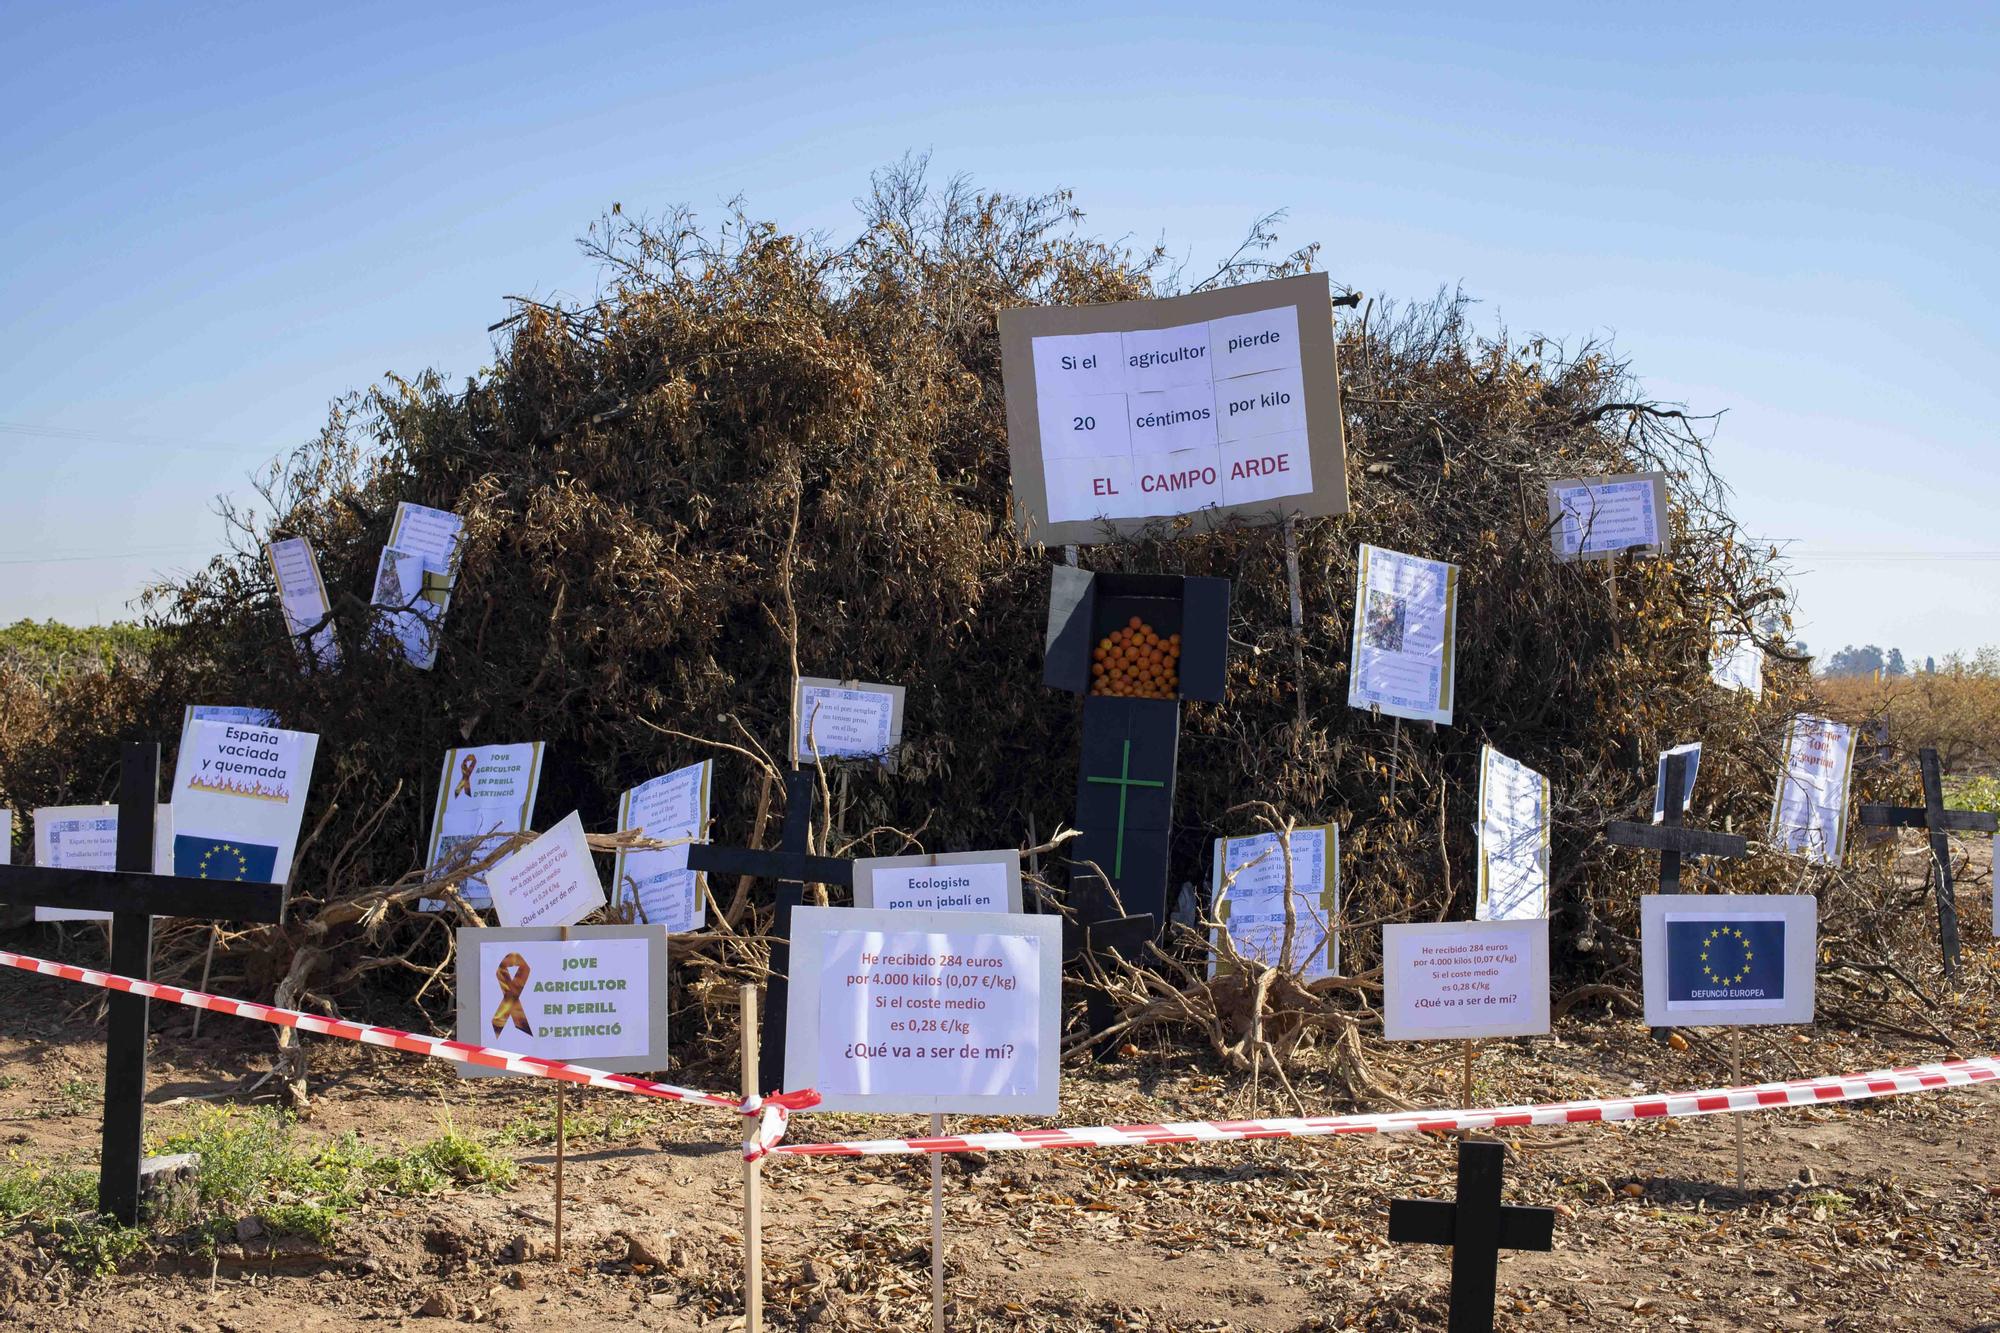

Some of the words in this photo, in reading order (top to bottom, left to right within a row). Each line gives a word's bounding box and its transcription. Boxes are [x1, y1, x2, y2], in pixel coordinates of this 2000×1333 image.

[1061, 356, 1077, 370] Si
[1082, 355, 1097, 369] el
[1129, 345, 1206, 369] agricultor
[1228, 330, 1280, 354] pierde
[1073, 416, 1096, 431] 20
[1136, 407, 1211, 428] céntimos
[1229, 399, 1256, 417] por
[1260, 391, 1291, 409] kilo
[1093, 477, 1119, 497] EL
[1141, 466, 1217, 493] CAMPO
[1231, 453, 1290, 481] ARDE
[225, 726, 279, 745] España
[218, 745, 279, 762] vaciada
[202, 758, 211, 770] y
[215, 761, 287, 780] quemada
[475, 765, 521, 774] AGRICULTOR
[473, 789, 514, 798] D'EXTINCIÓ
[908, 877, 970, 890] Ecologista
[537, 907, 545, 916] va
[549, 897, 559, 907] ser
[559, 890, 568, 900] de
[890, 900, 913, 910] pon
[917, 899, 932, 907] un
[937, 894, 971, 909] jabalí
[975, 896, 990, 905] en
[1435, 945, 1467, 954] recibido
[1469, 944, 1484, 953] 284
[1485, 944, 1508, 952] euros
[562, 958, 597, 971] JOVE
[862, 953, 879, 965] He
[882, 954, 936, 966] recibido
[940, 954, 963, 967] 284
[966, 957, 1003, 968] euros
[1473, 955, 1494, 965] (0,07
[1495, 953, 1517, 964] €/kg)
[1432, 971, 1440, 979] Si
[1473, 968, 1499, 977] medio
[533, 979, 626, 992] AGRICULTOR
[847, 975, 869, 986] por
[872, 973, 909, 986] 4.000
[912, 974, 942, 986] kilos
[946, 973, 978, 989] (0,07
[982, 974, 1016, 990] €/kg)
[1452, 983, 1470, 992] 0,28
[1471, 981, 1490, 991] €/kg
[1691, 988, 1728, 998] DEFUNCIÓ
[1729, 989, 1765, 998] EUROPEA
[543, 1004, 563, 1015] EN
[567, 1002, 616, 1014] PERILL
[875, 996, 887, 1008] Si
[890, 996, 902, 1008] el
[906, 998, 941, 1009] coste
[944, 998, 986, 1010] medio
[1414, 998, 1441, 1008] ¿Qué
[1483, 995, 1497, 1004] de
[538, 1022, 622, 1037] D'EXTINCIÓ
[890, 1021, 905, 1031] es
[908, 1019, 937, 1033] 0,28
[940, 1019, 970, 1035] €/kg
[844, 1042, 887, 1059] ¿Qué
[892, 1047, 911, 1058] va
[916, 1047, 925, 1058] a
[930, 1047, 955, 1059] ser
[959, 1044, 980, 1059] de
[985, 1044, 1014, 1060] mí?
